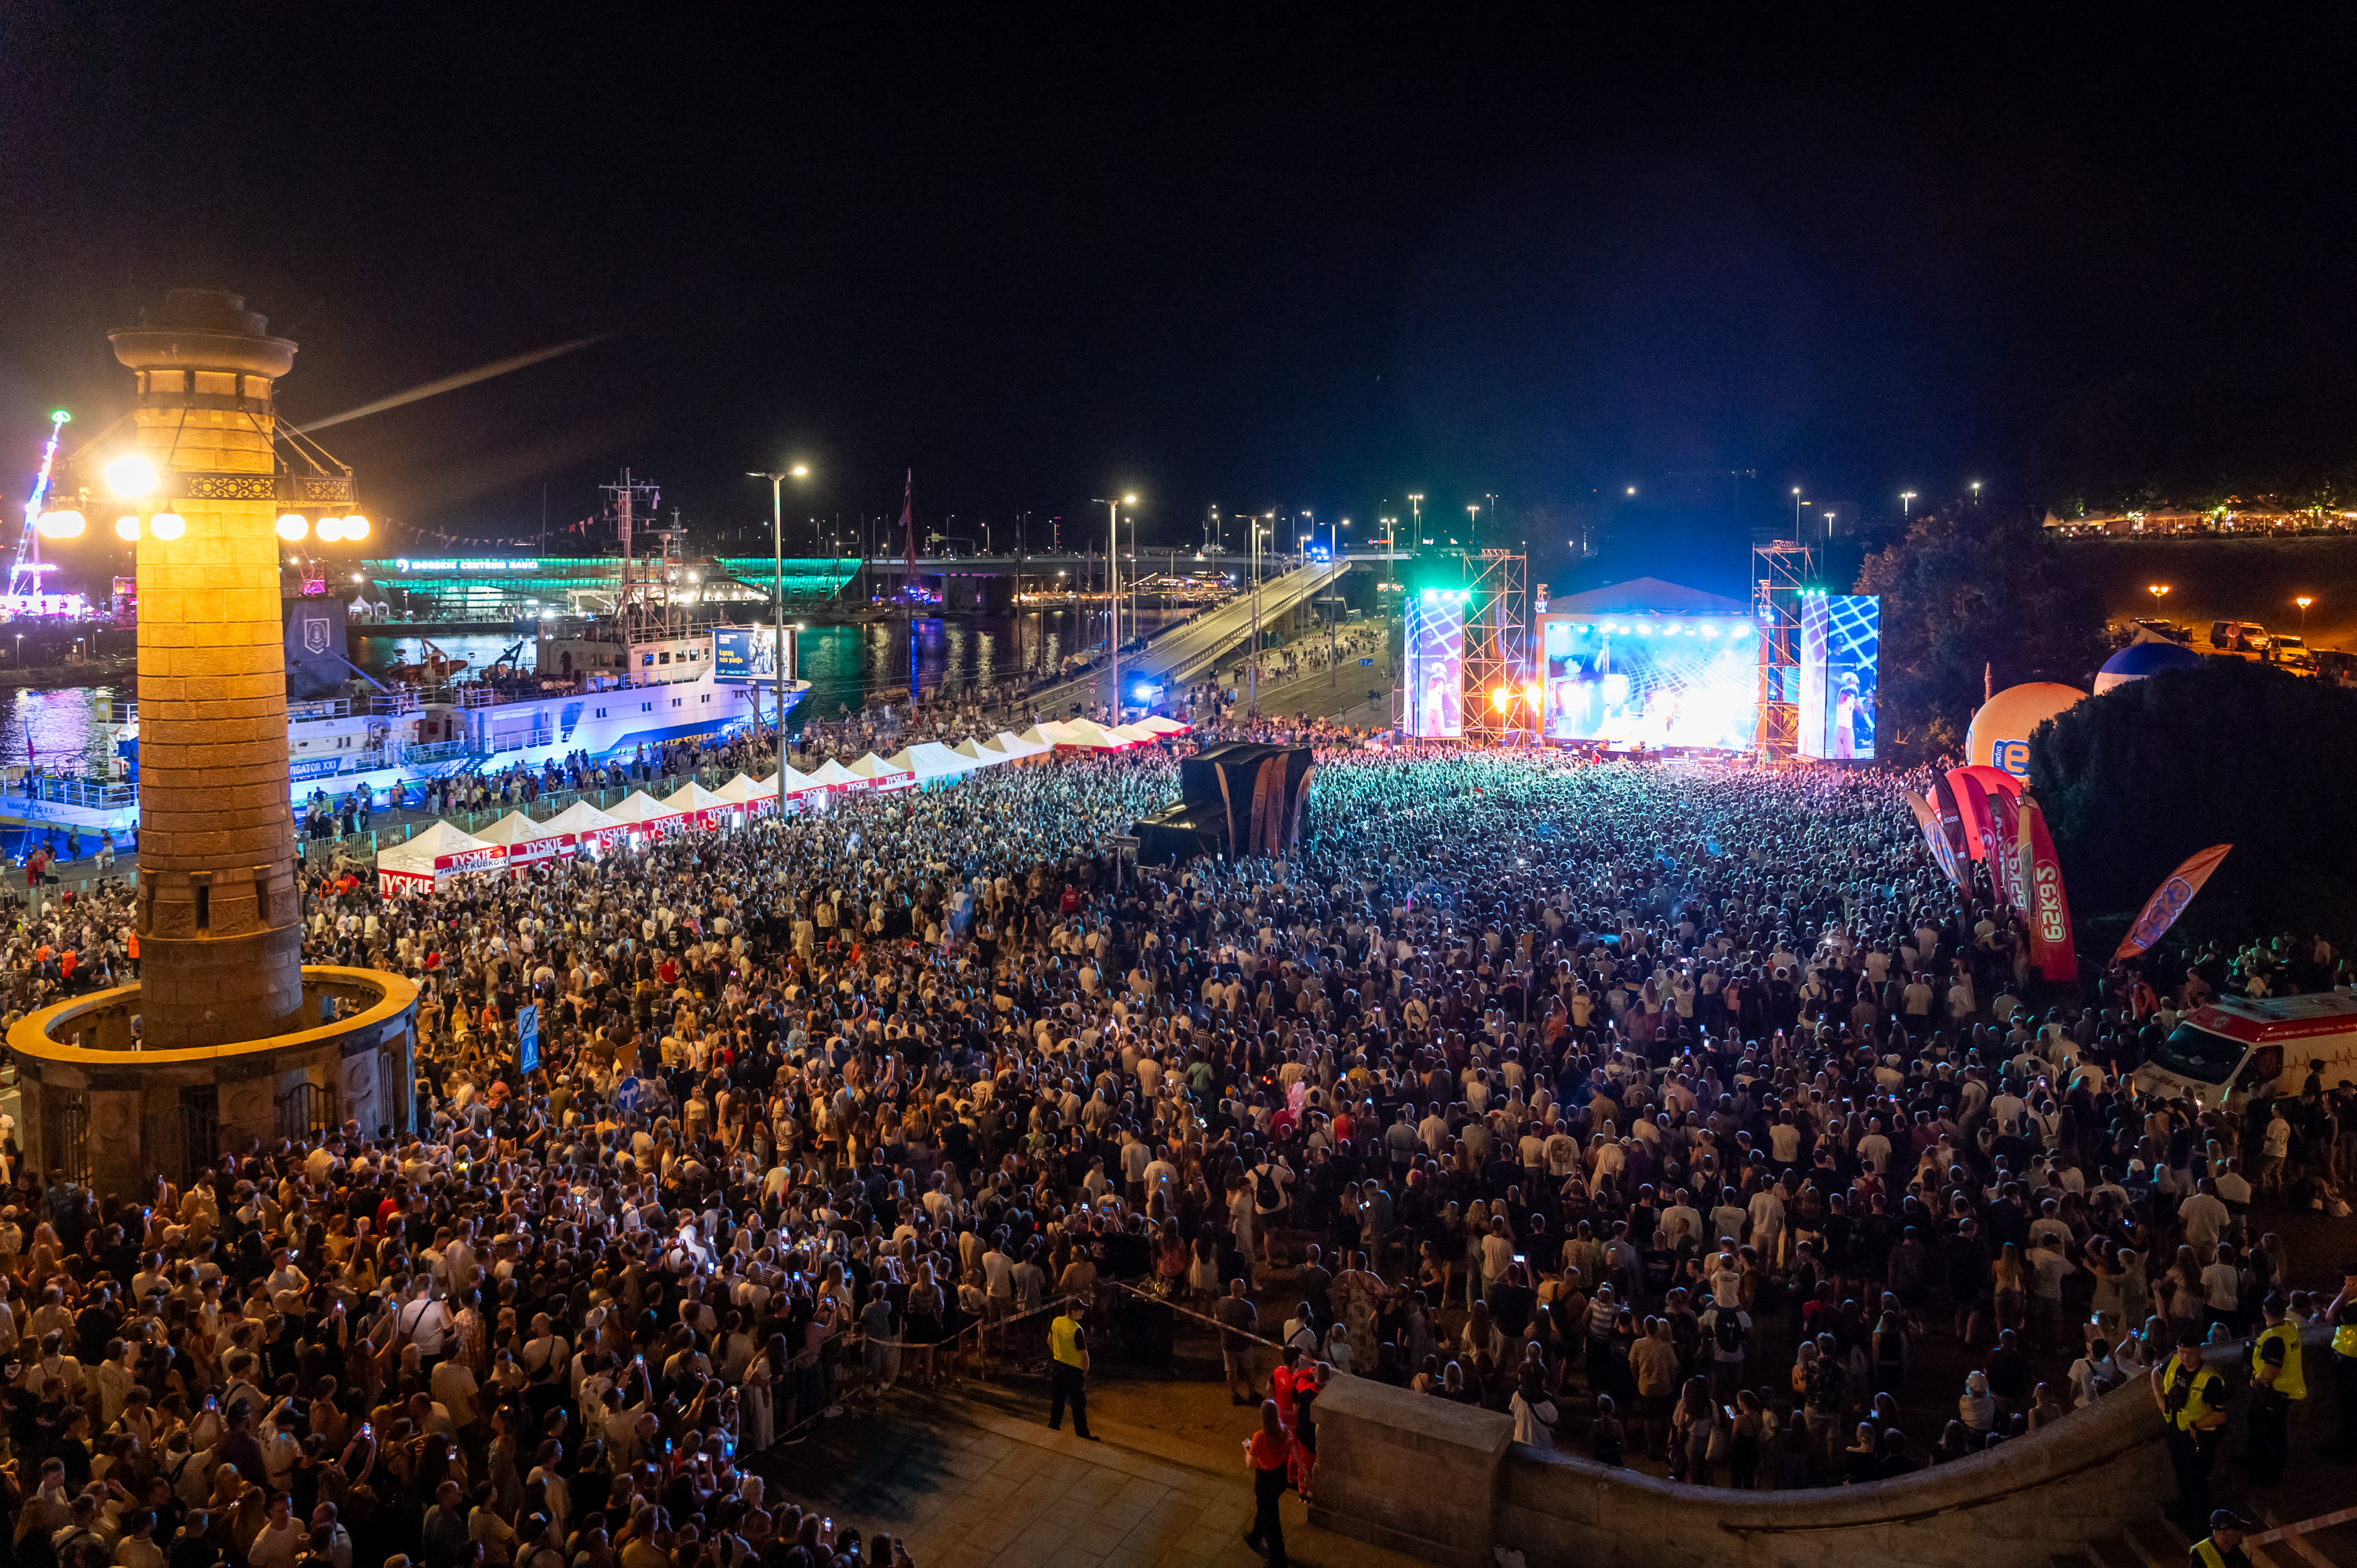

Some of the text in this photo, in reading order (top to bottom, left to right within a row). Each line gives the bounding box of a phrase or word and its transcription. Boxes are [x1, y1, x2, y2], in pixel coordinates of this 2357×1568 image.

[322, 760, 337, 771] XXI
[846, 780, 870, 792] TYSKIE
[885, 773, 908, 786] TYSKIE
[801, 786, 829, 800] TYSKIE
[756, 797, 778, 811] TYSKI
[706, 804, 735, 820] TYSKIE
[651, 815, 684, 830] TYSKIE
[593, 826, 629, 841] TYSKIE
[524, 837, 564, 855] TYSKIE
[449, 848, 493, 867] TYSKIE
[379, 872, 434, 895] TYSKIE
